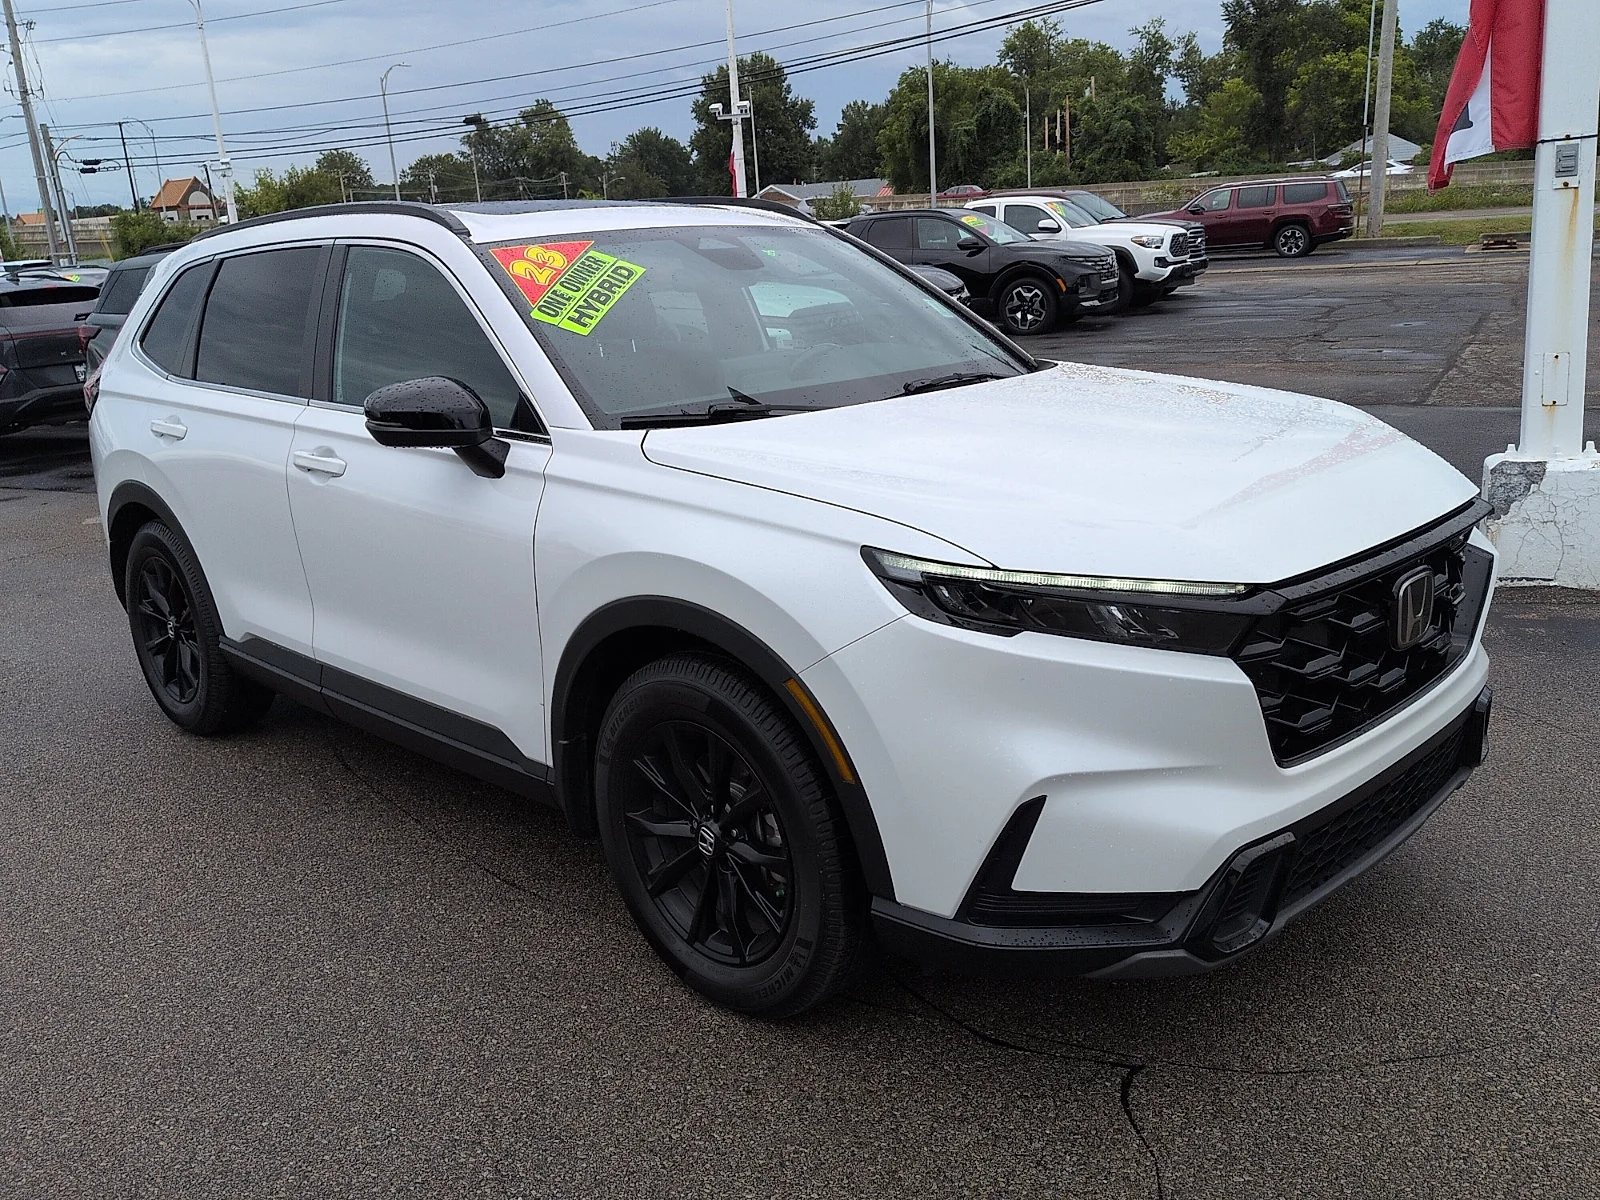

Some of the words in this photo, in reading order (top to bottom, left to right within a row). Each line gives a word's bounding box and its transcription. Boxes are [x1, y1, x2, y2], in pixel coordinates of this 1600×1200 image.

[509, 246, 567, 285] 23
[537, 289, 575, 318] ONE
[559, 255, 607, 293] OWNER
[567, 265, 638, 329] HYBRID
